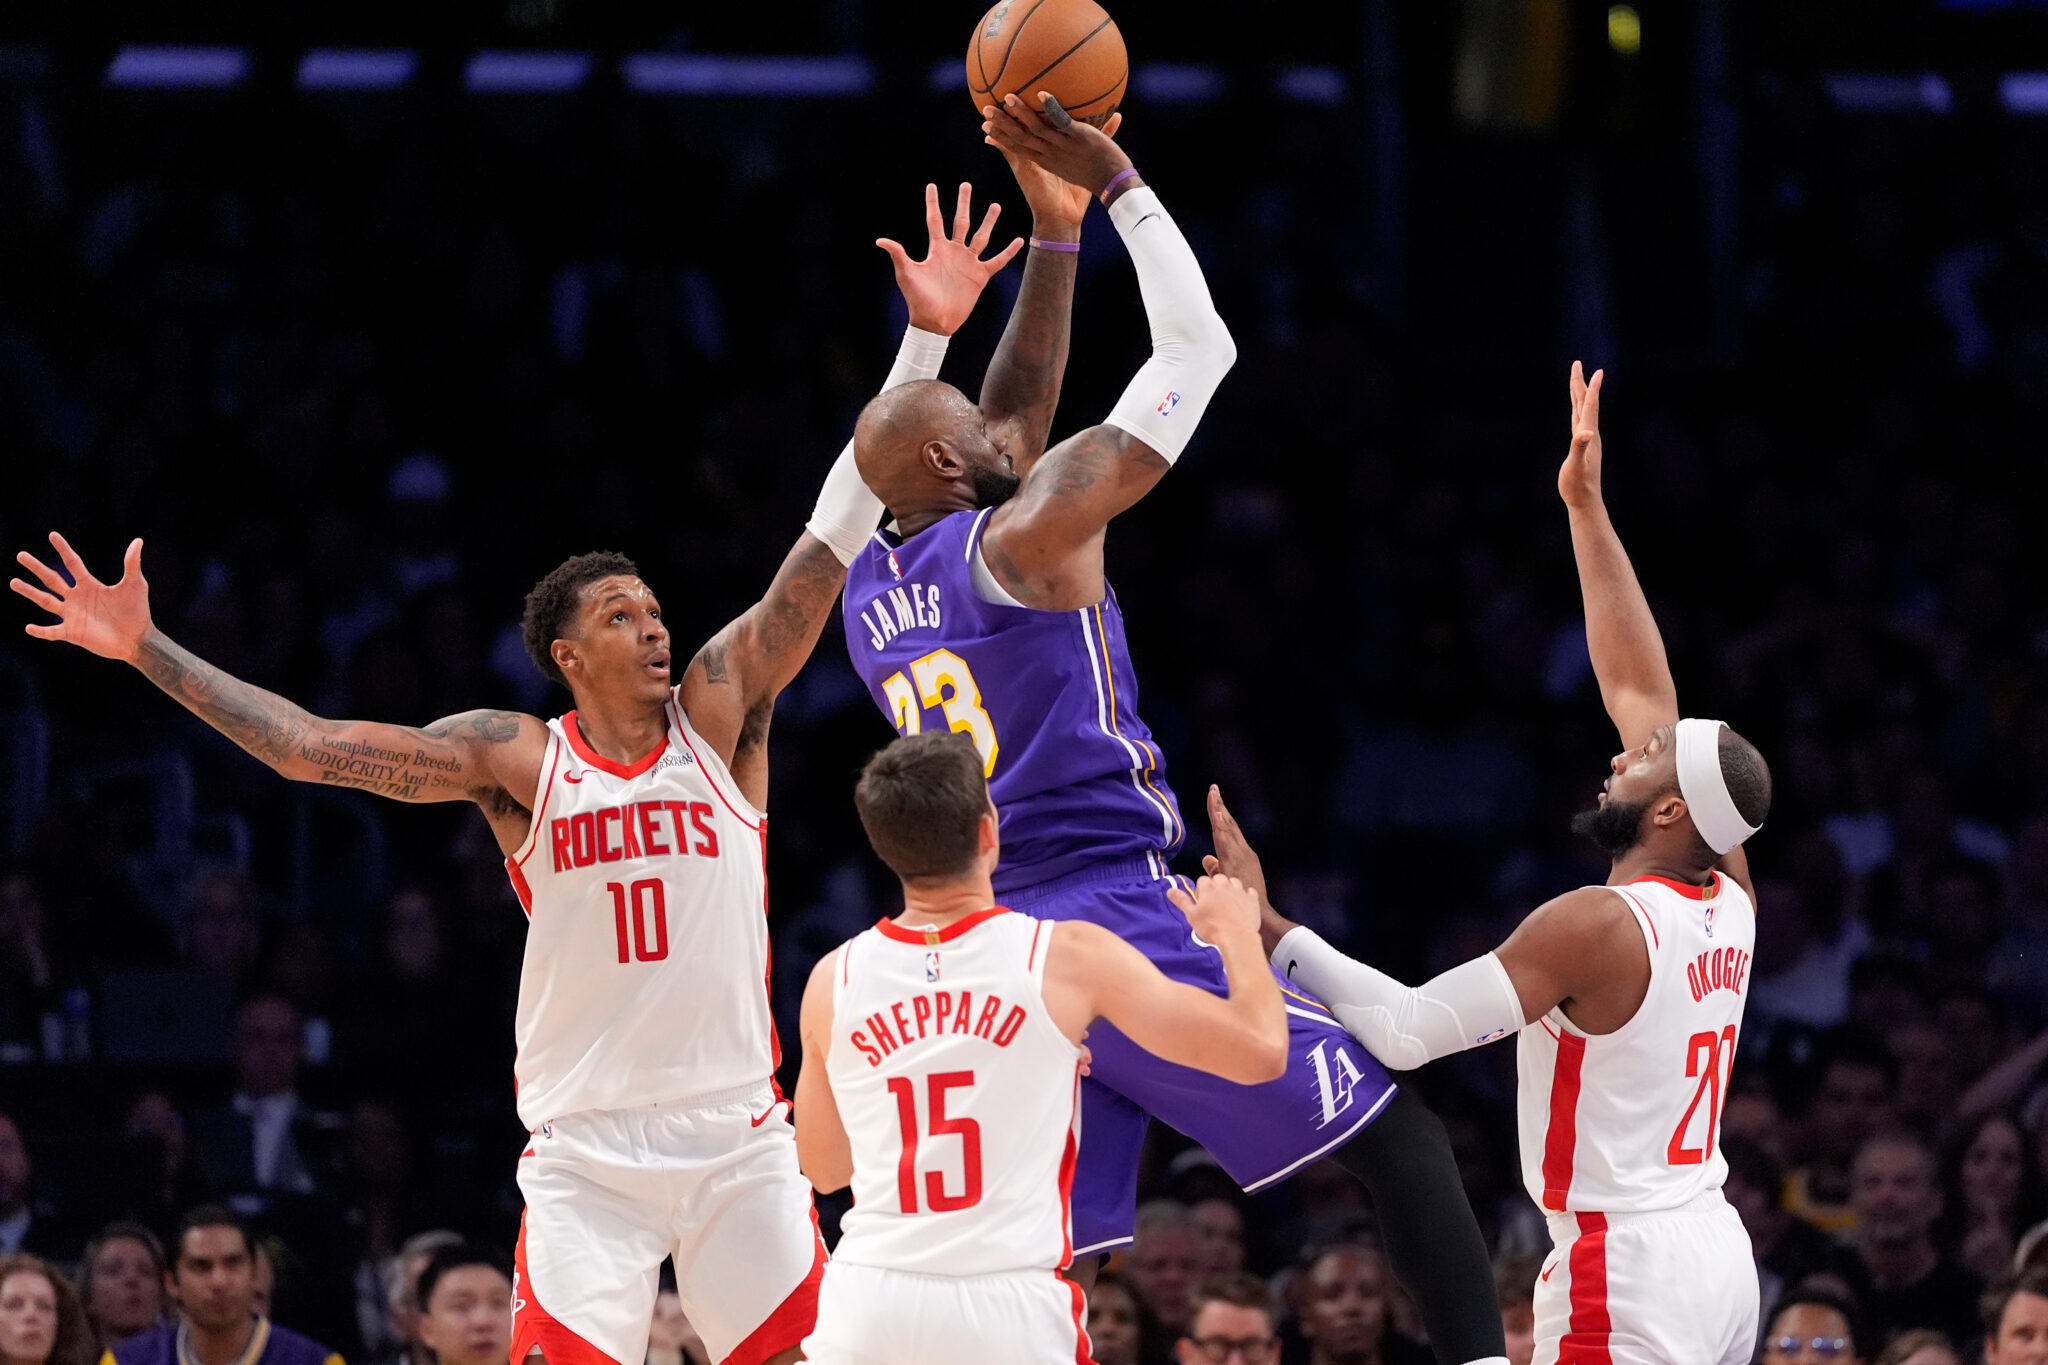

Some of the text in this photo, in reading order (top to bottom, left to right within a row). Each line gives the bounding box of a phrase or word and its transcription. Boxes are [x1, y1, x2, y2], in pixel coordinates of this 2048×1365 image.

[861, 583, 941, 651] JAMES
[296, 744, 398, 781] MEDIOCRITY
[399, 769, 430, 785] And
[321, 736, 462, 773] Complacency Breeds
[551, 800, 719, 874] ROCKETS
[606, 877, 669, 964] 10
[1687, 946, 1749, 1003] OKOGIE
[850, 991, 1026, 1067] SHEPPARD
[1667, 1024, 1736, 1166] 20
[887, 1070, 983, 1214] 15
